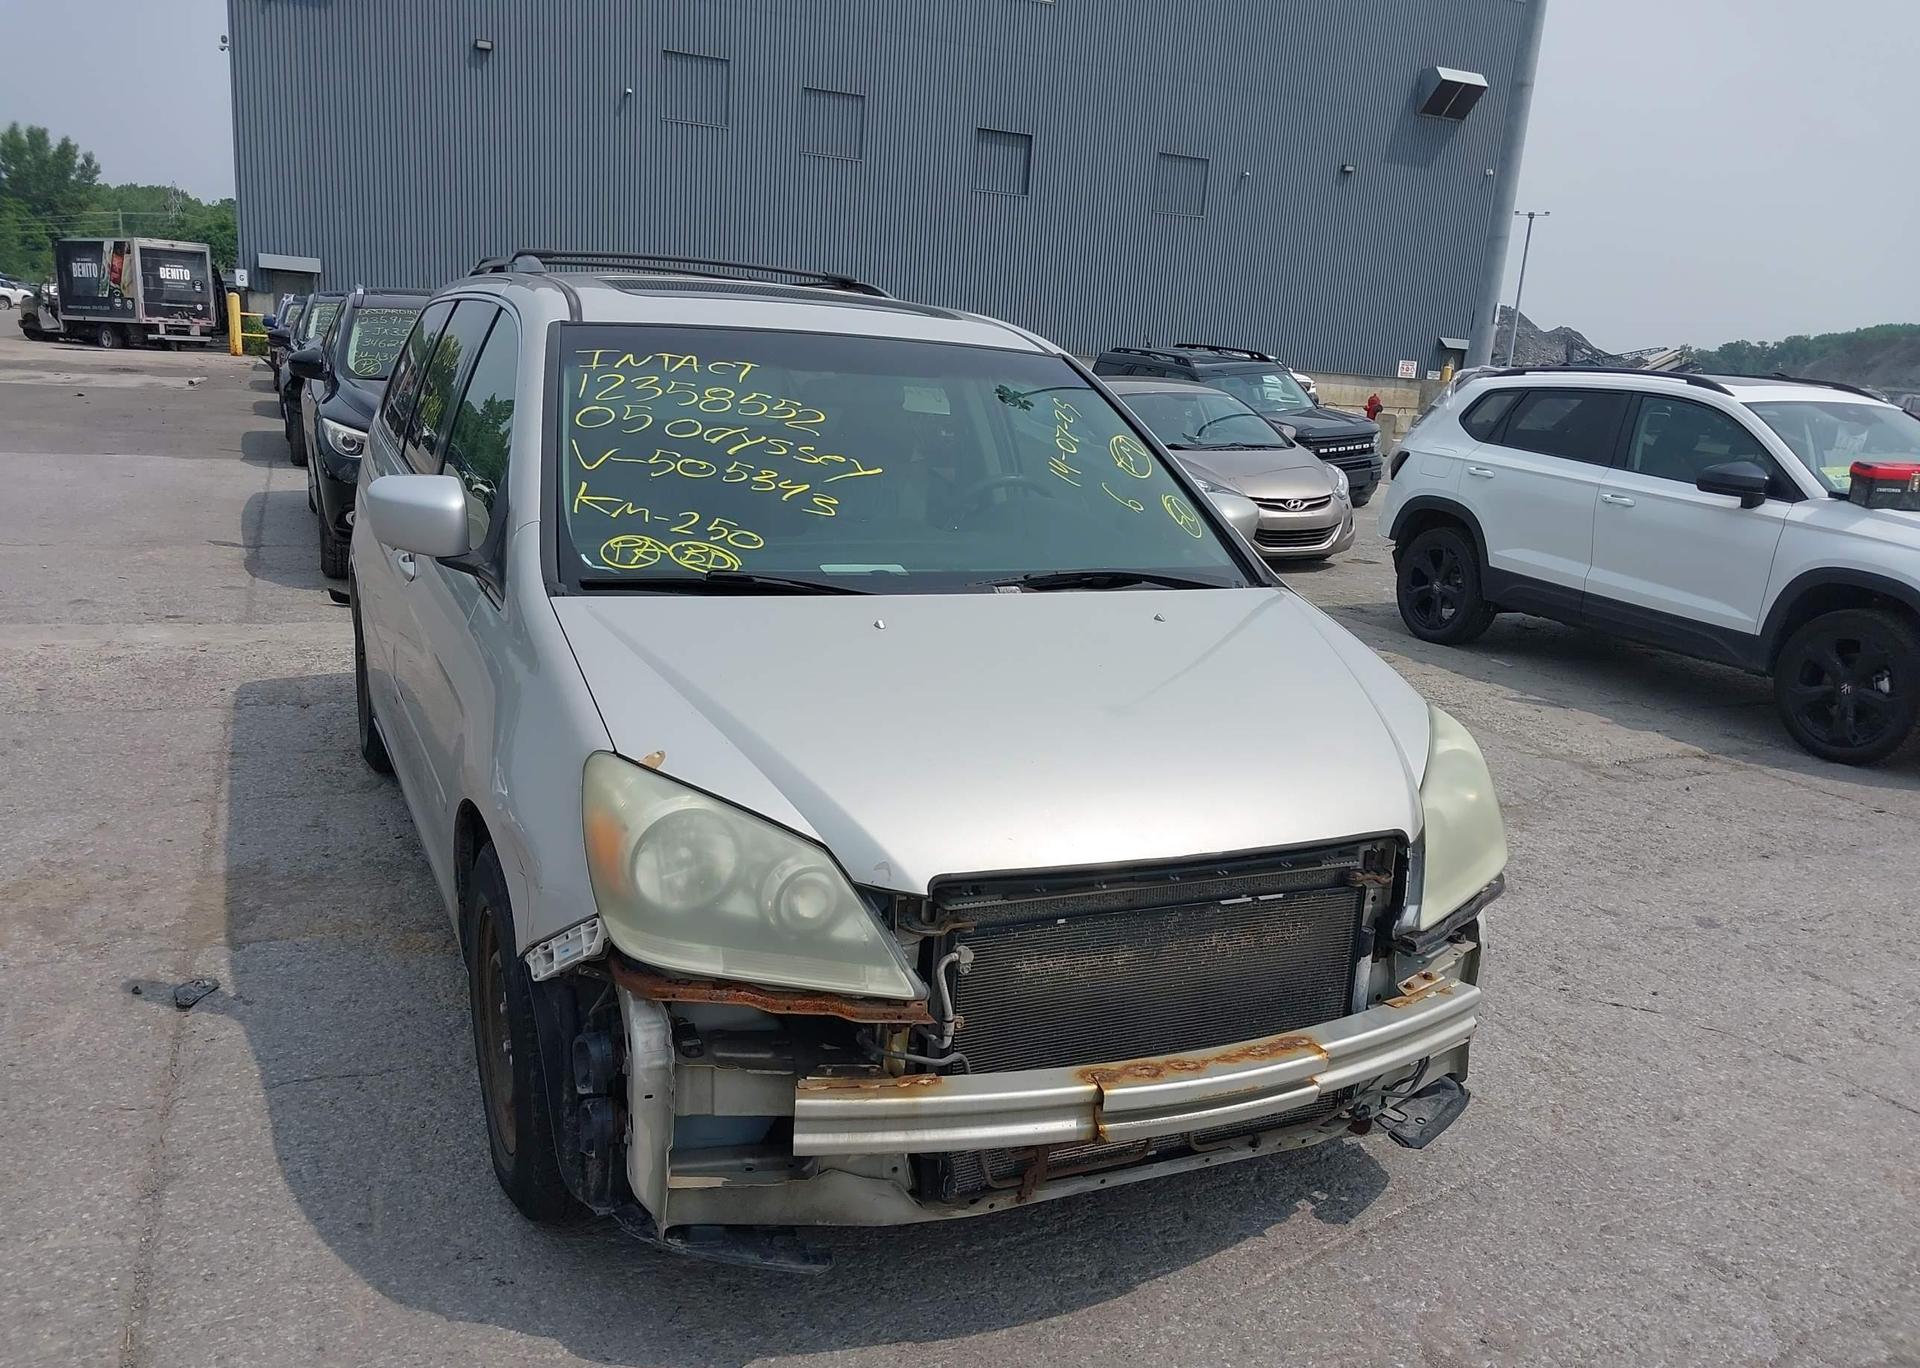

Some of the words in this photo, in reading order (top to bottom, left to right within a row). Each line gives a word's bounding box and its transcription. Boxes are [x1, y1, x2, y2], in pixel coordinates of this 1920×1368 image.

[72, 262, 98, 278] BENITO
[159, 267, 191, 281] BENITO
[359, 308, 418, 316] DESJARDIN
[575, 349, 761, 383] INTACT
[579, 373, 826, 436] 12358552
[575, 404, 654, 434] 05
[1319, 443, 1370, 454] BRONCO
